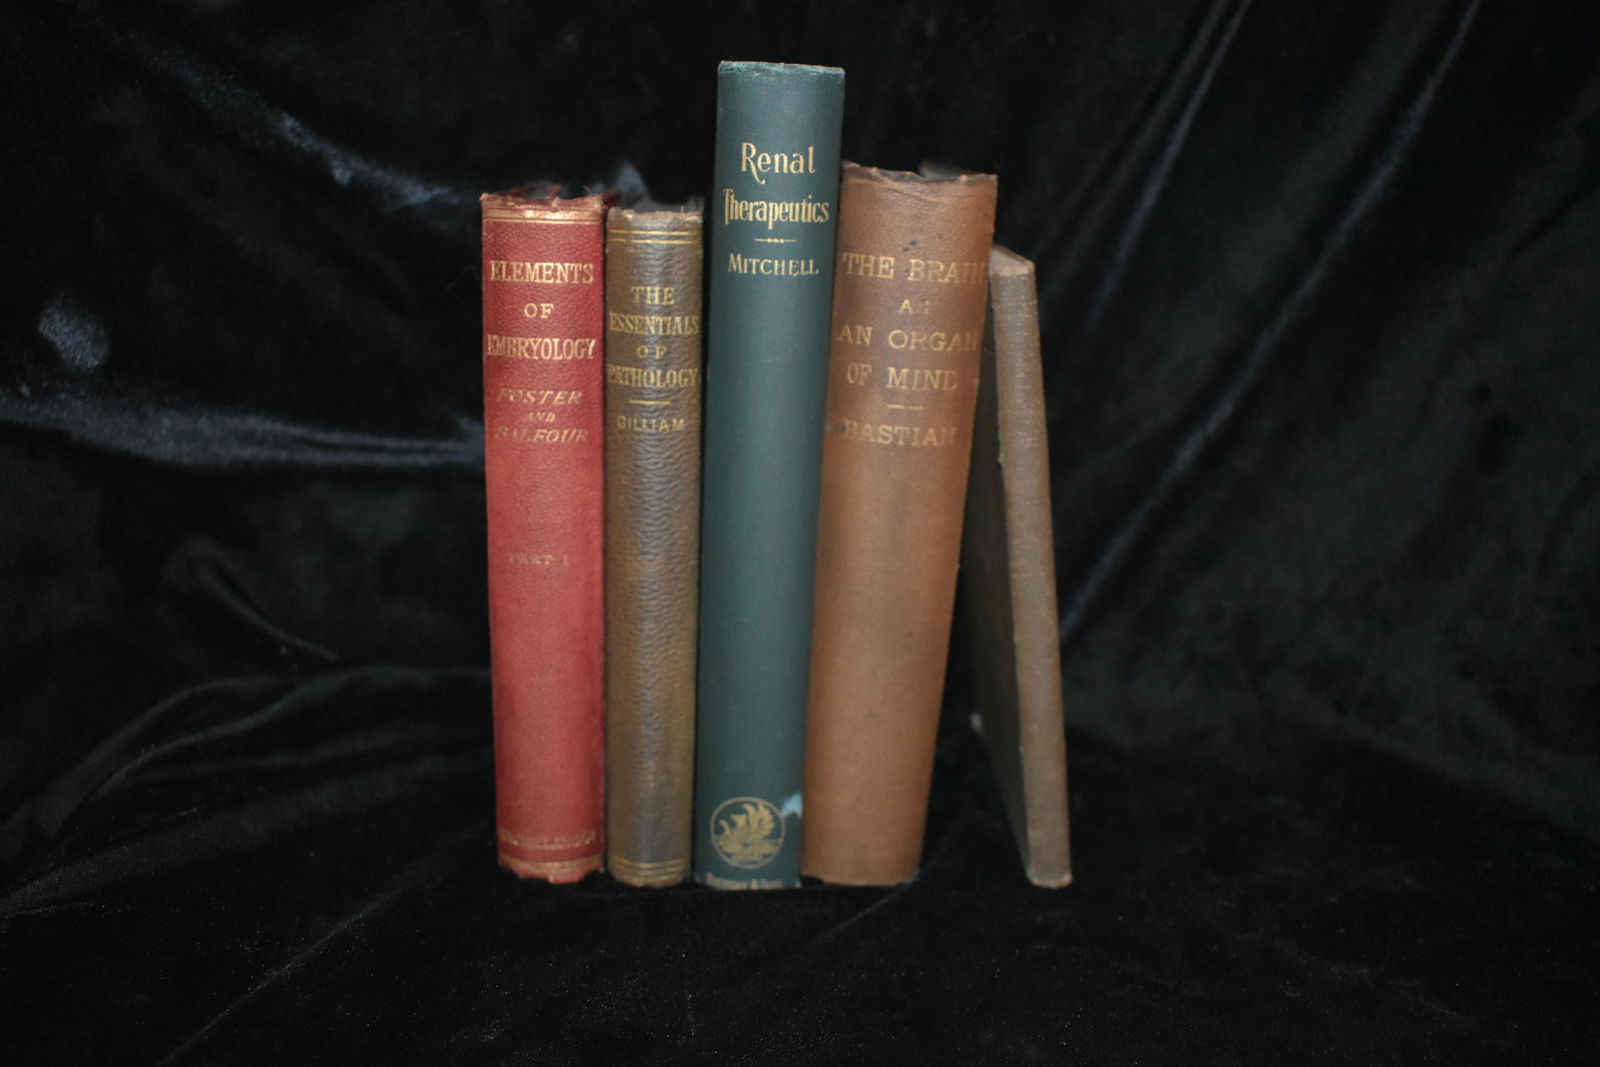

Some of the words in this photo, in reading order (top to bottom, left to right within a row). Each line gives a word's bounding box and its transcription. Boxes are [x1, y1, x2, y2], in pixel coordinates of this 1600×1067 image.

[741, 142, 816, 185] Renal
[723, 188, 830, 230] Therapeutics
[490, 260, 594, 284] ELEMENTS
[728, 253, 819, 276] MITCHELL
[843, 253, 895, 280] THE
[908, 259, 986, 284] BRAIN
[632, 286, 675, 305] THE
[524, 303, 554, 319] OF
[609, 312, 700, 336] ESSENTIALS
[837, 324, 874, 346] AN
[487, 334, 596, 360] EMBRYOLOGY
[636, 345, 666, 359] OF
[608, 364, 698, 388] PATHOLOGY
[847, 363, 873, 386] OF
[886, 366, 958, 391] MIND
[498, 388, 582, 405] FOSTER
[617, 416, 684, 432] GILLIAM
